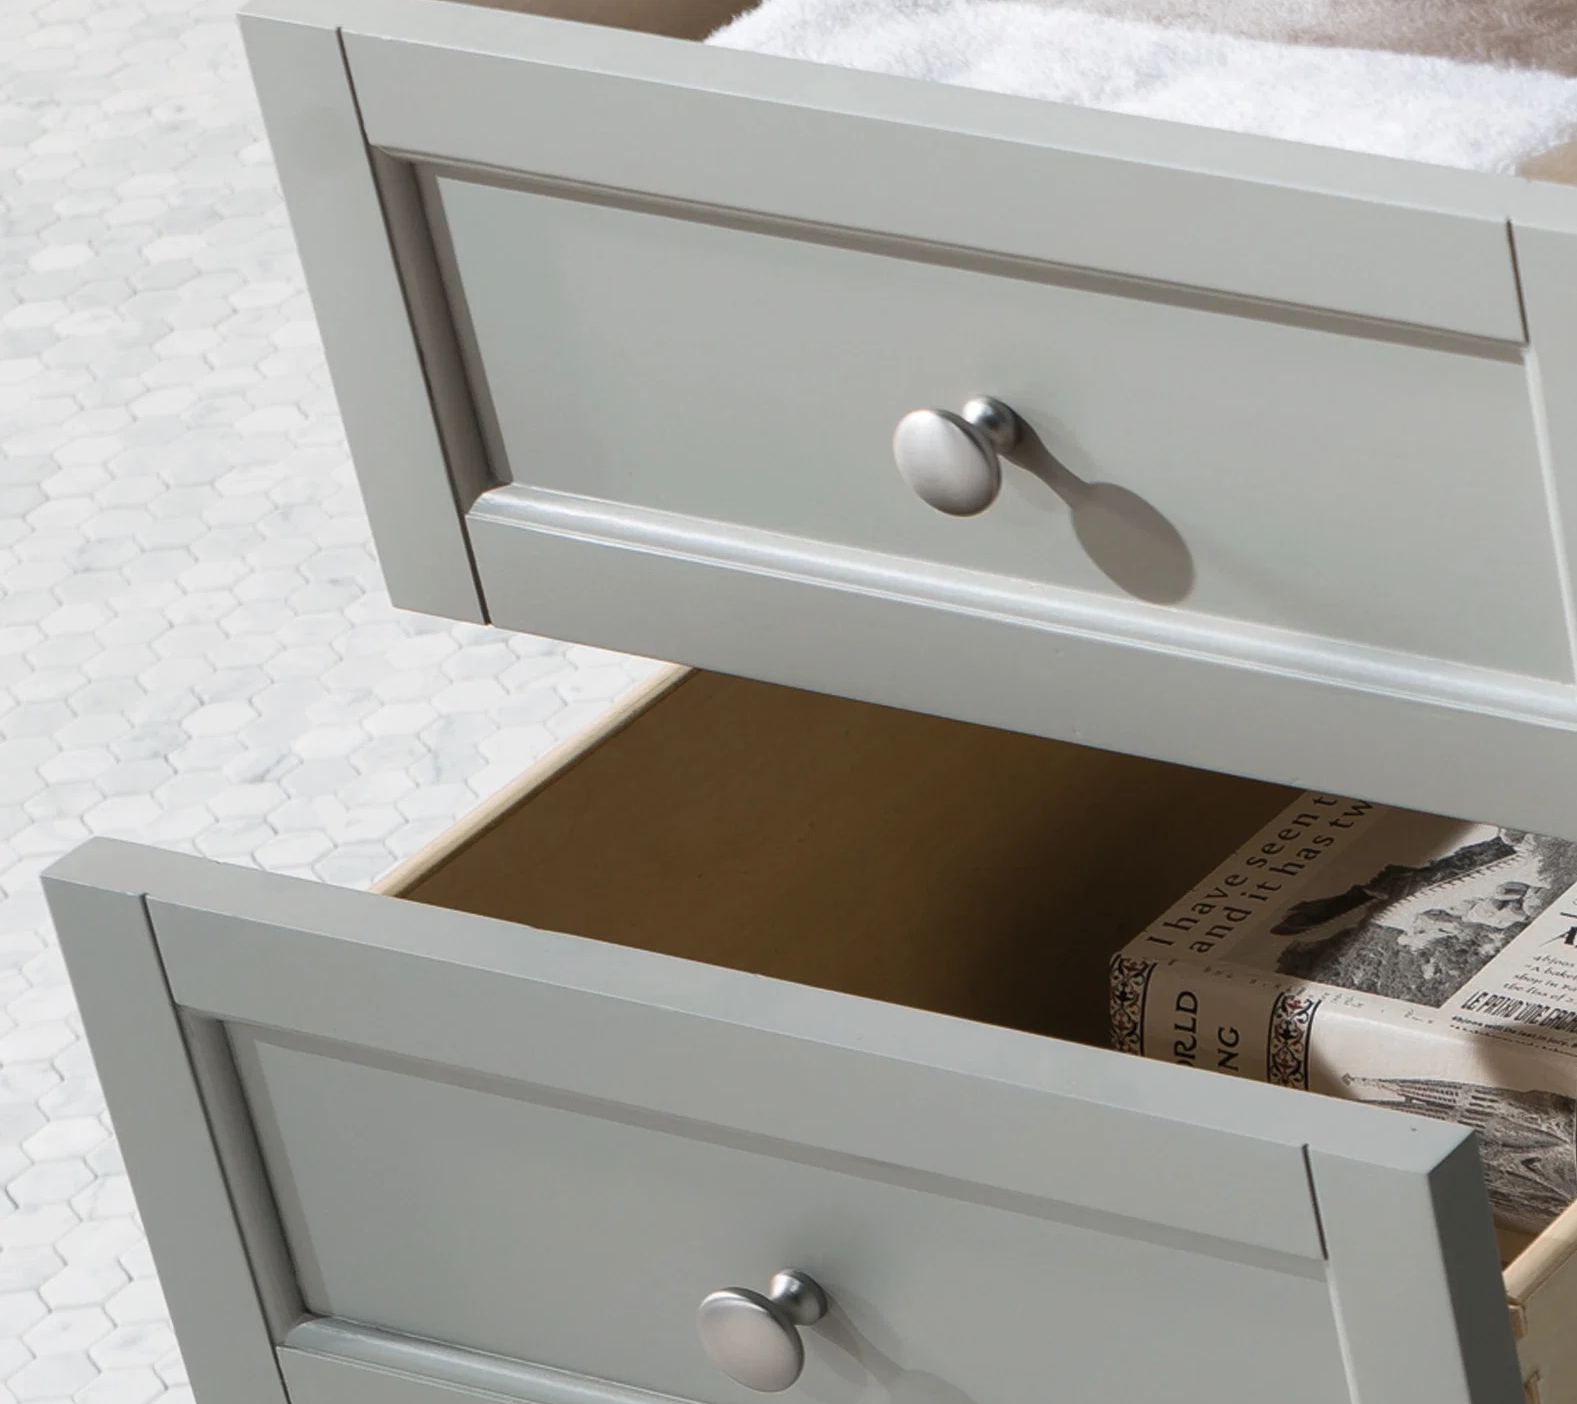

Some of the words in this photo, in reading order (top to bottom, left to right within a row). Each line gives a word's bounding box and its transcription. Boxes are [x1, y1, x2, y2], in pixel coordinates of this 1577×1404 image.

[1162, 872, 1249, 932] have
[1245, 811, 1321, 869] seen
[1188, 905, 1254, 954] and
[1239, 879, 1283, 903] it
[1268, 833, 1336, 877] has
[1173, 990, 1198, 1067] RLD
[1460, 990, 1489, 1010] LE
[1216, 1026, 1240, 1072] NG
